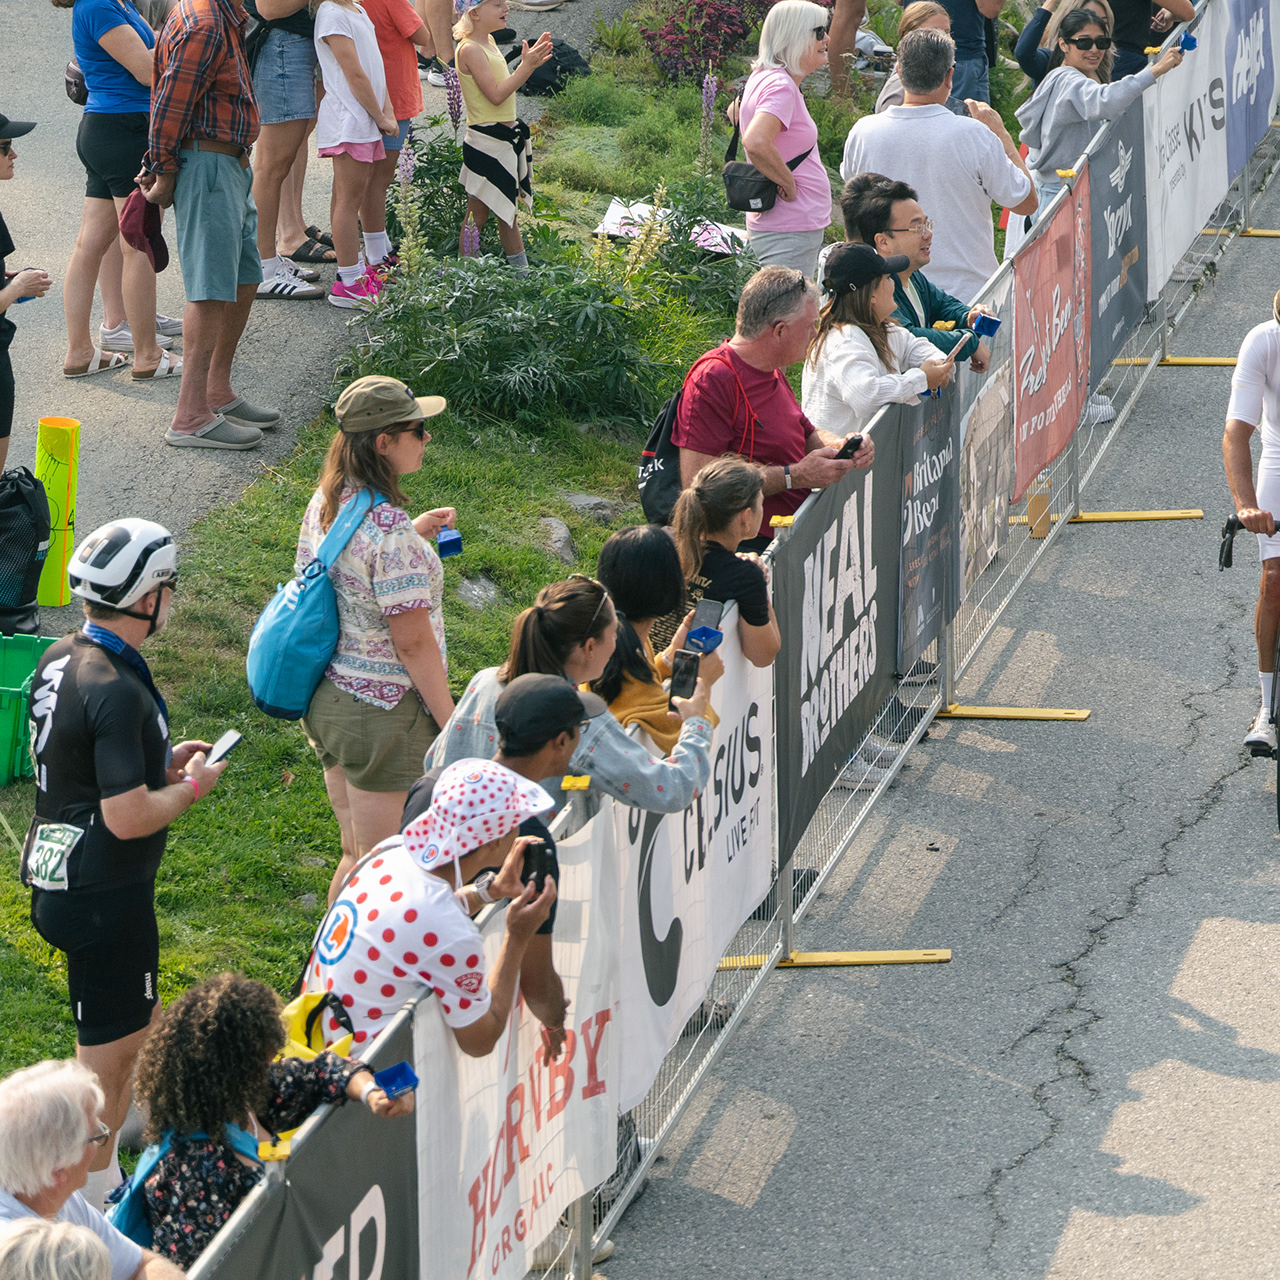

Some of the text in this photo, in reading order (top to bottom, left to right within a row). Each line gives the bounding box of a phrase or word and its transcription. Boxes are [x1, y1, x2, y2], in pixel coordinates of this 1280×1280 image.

[800, 468, 877, 699] NEAL
[800, 599, 878, 779] BROTHERS
[32, 844, 65, 883] 382
[726, 815, 748, 864] LIVE
